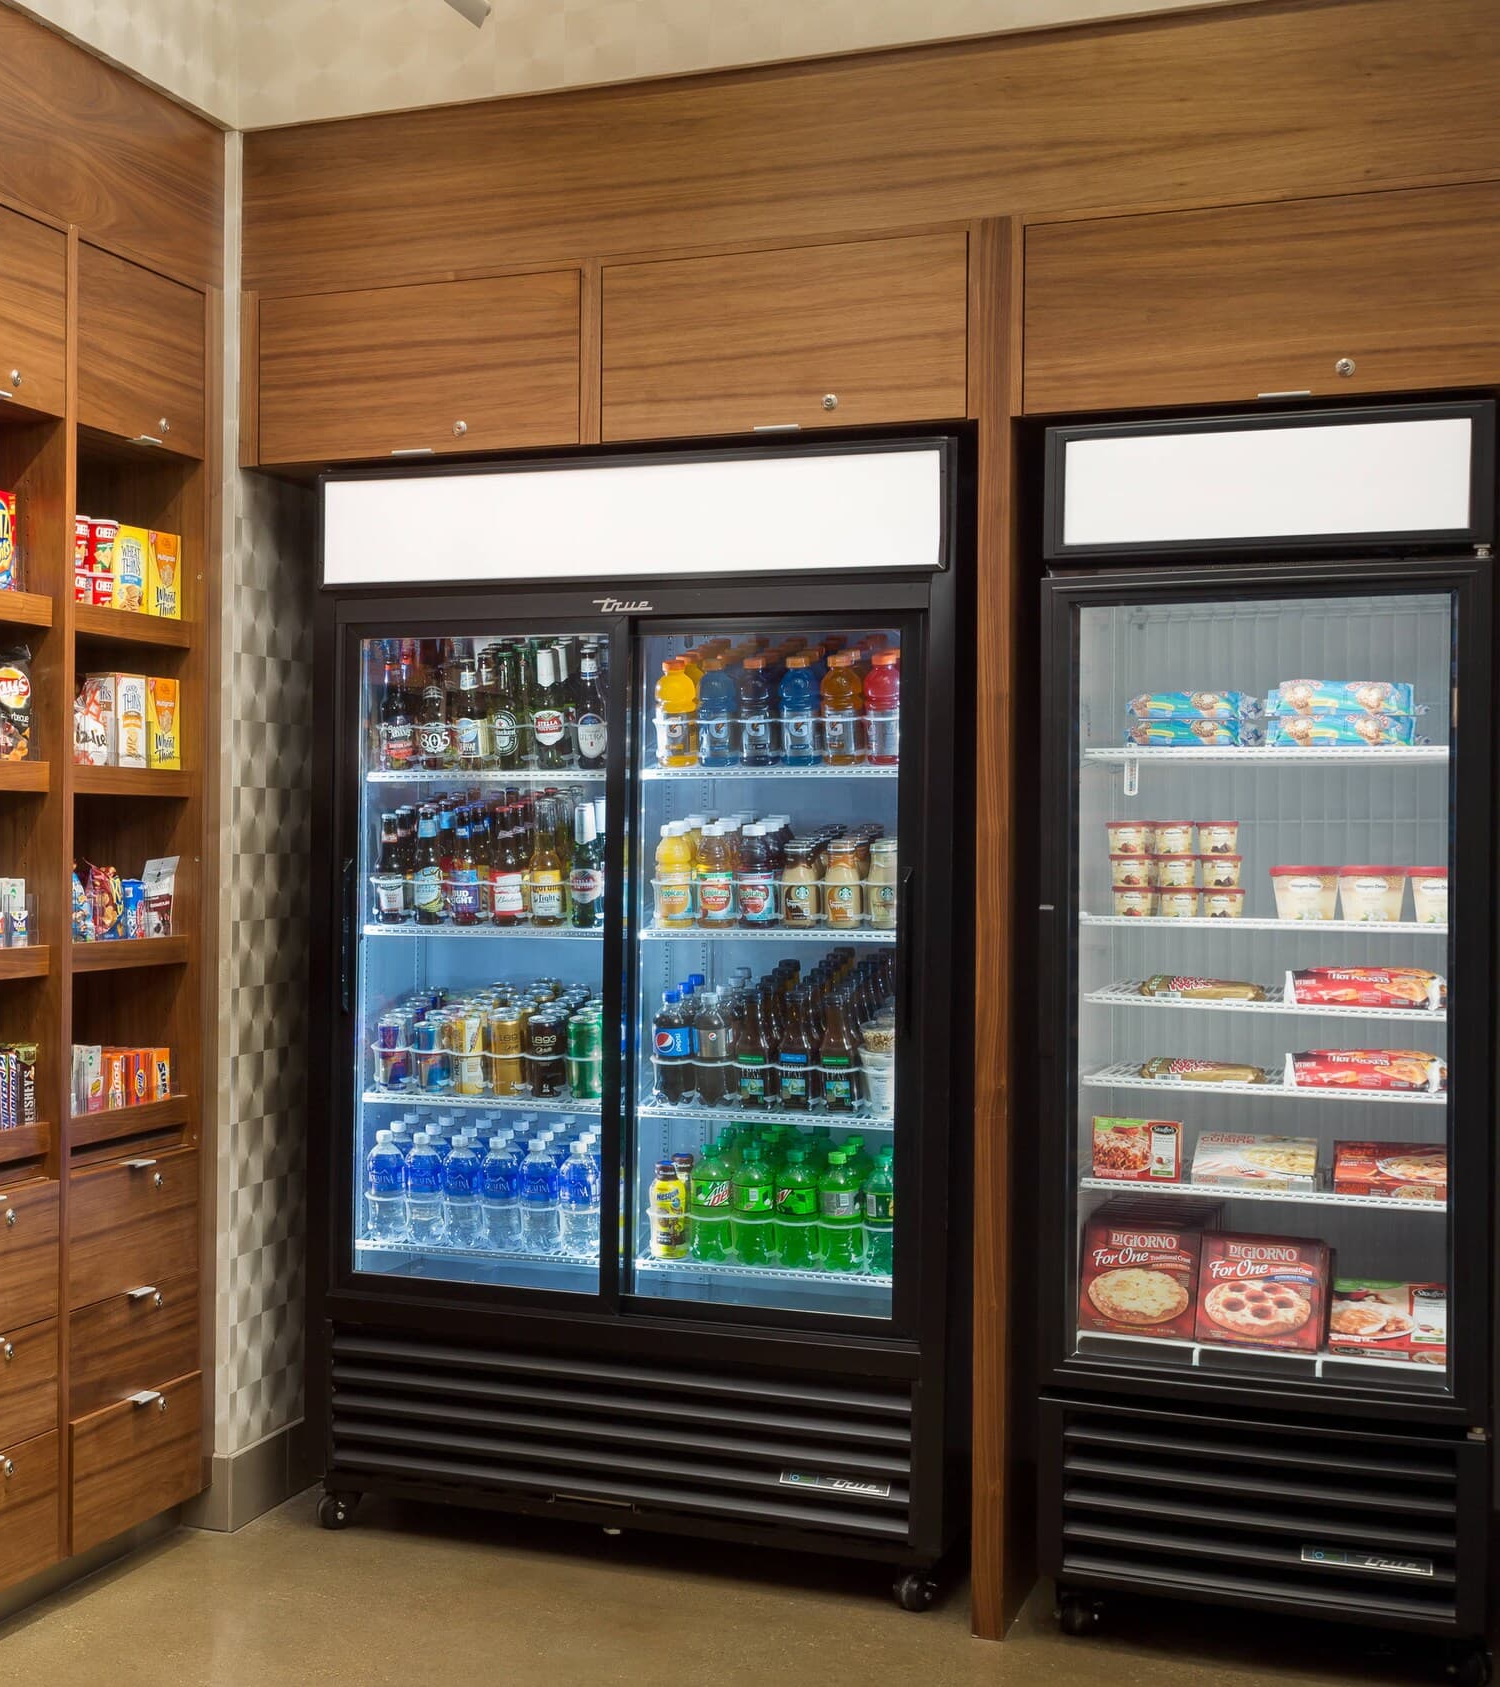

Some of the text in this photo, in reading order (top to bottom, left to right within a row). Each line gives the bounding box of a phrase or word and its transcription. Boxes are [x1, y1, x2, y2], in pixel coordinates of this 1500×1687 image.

[537, 720, 558, 728] STELLA
[420, 731, 450, 749] 805
[1331, 972, 1391, 984] HOT POCKETS
[531, 1034, 557, 1044] 1893
[674, 1033, 683, 1053] pepsi
[1331, 1054, 1391, 1067] HOT POCKETS
[1092, 1248, 1118, 1268] For
[1118, 1246, 1150, 1265] One
[1208, 1260, 1237, 1279] For
[1236, 1259, 1270, 1277] One
[1416, 1289, 1446, 1299] Stouffer
